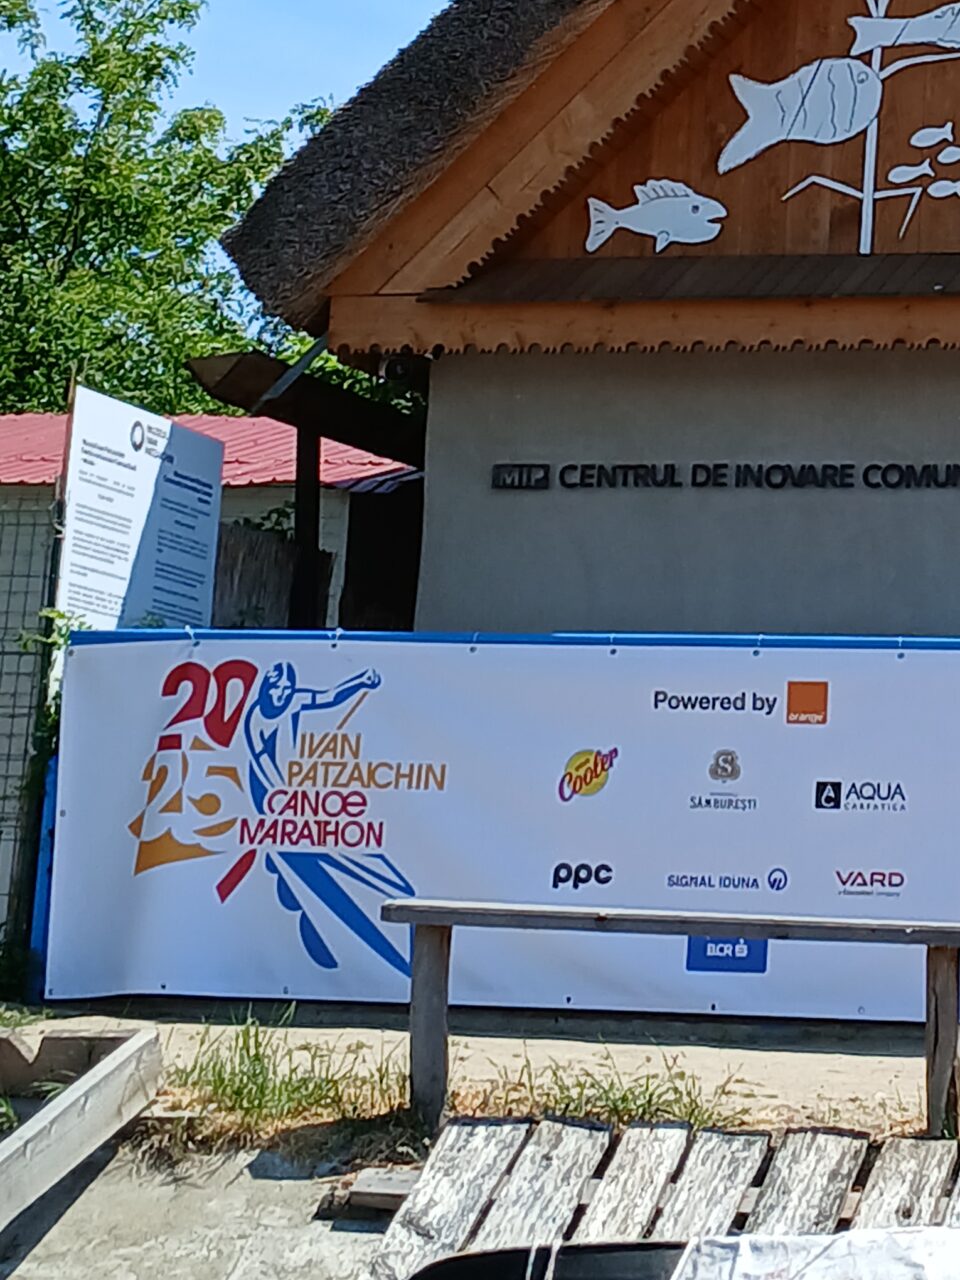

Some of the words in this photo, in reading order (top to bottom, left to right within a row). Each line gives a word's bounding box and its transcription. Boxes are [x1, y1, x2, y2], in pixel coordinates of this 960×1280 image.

[559, 464, 683, 489] CENTRUL
[691, 464, 729, 488] DE
[735, 464, 855, 489] INOVARE
[158, 659, 259, 751] 20
[653, 690, 746, 711] Powered
[752, 692, 778, 716] by
[300, 732, 362, 760] IVAN
[287, 761, 447, 791] PATZAICHIN
[558, 746, 619, 803] Cooler
[845, 782, 906, 801] AQUA
[239, 818, 384, 848] MARATHON
[552, 862, 613, 889] ppc
[719, 875, 760, 889] IDUNA
[835, 870, 905, 887] VARD
